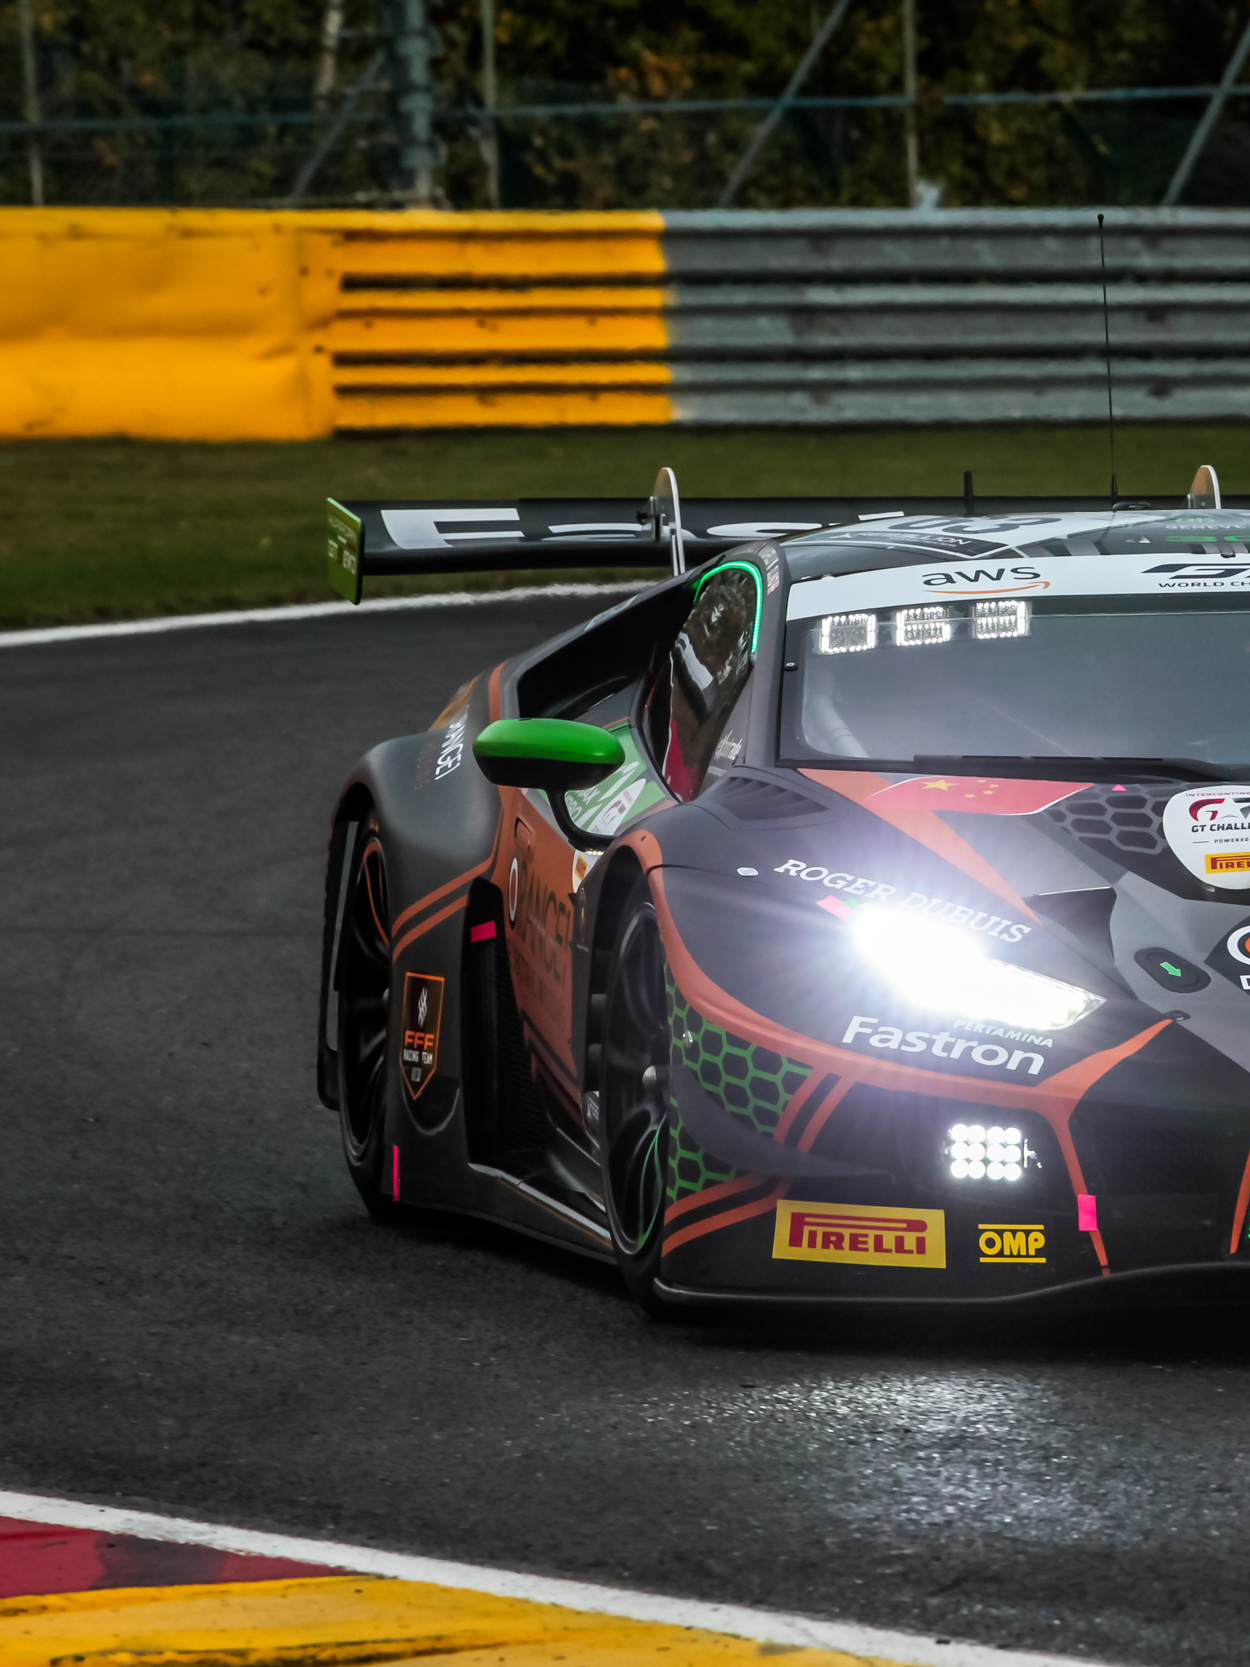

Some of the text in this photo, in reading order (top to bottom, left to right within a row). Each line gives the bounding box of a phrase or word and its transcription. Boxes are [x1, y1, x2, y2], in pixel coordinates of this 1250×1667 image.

[922, 566, 1042, 587] aws
[1191, 824, 1207, 833] GT
[774, 859, 1031, 943] ROGER DUBUIS
[404, 1030, 434, 1050] FFF
[842, 1015, 1045, 1075] Fastron
[953, 1019, 1053, 1047] PERTAMINA
[788, 1212, 928, 1255] PIRELLI
[979, 1231, 1045, 1256] OMP
